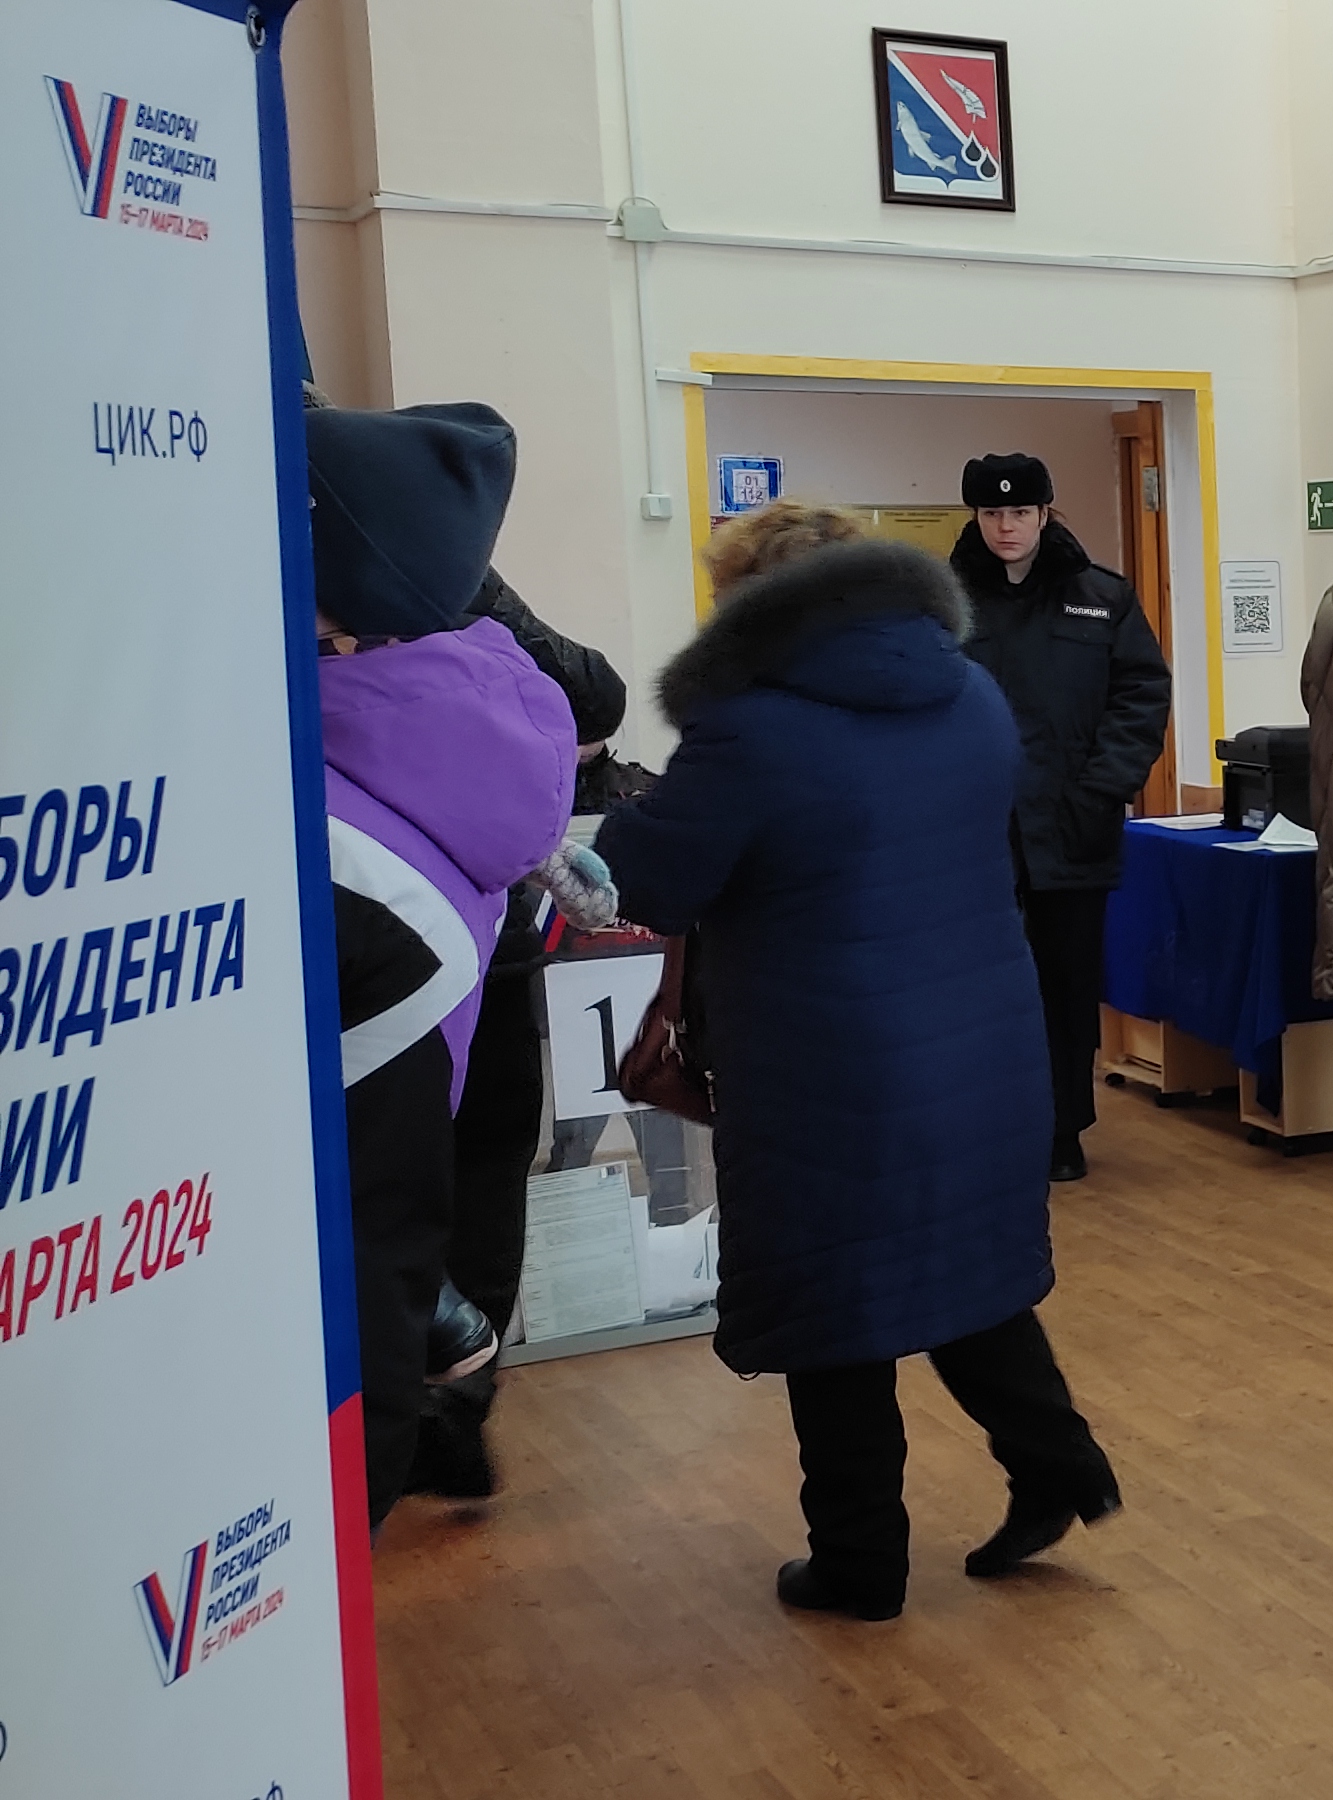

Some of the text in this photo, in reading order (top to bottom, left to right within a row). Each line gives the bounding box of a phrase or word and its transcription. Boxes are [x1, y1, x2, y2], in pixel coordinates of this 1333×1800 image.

[135, 103, 198, 142] ВЫБОРЫ
[123, 170, 183, 206] РОССИИ
[128, 137, 217, 182] ПРЕЗИДЕНТА
[150, 208, 184, 235] МАРТА
[93, 402, 207, 466] ЦИК.РФ
[584, 995, 622, 1094] 1
[110, 1171, 213, 1294] 2024
[209, 1518, 292, 1594] ПРЕЗИДЕНТА
[214, 1498, 275, 1557] ВЫБОРЫ
[204, 1572, 261, 1631] РОССИИ
[229, 1602, 262, 1643] МАРТА
